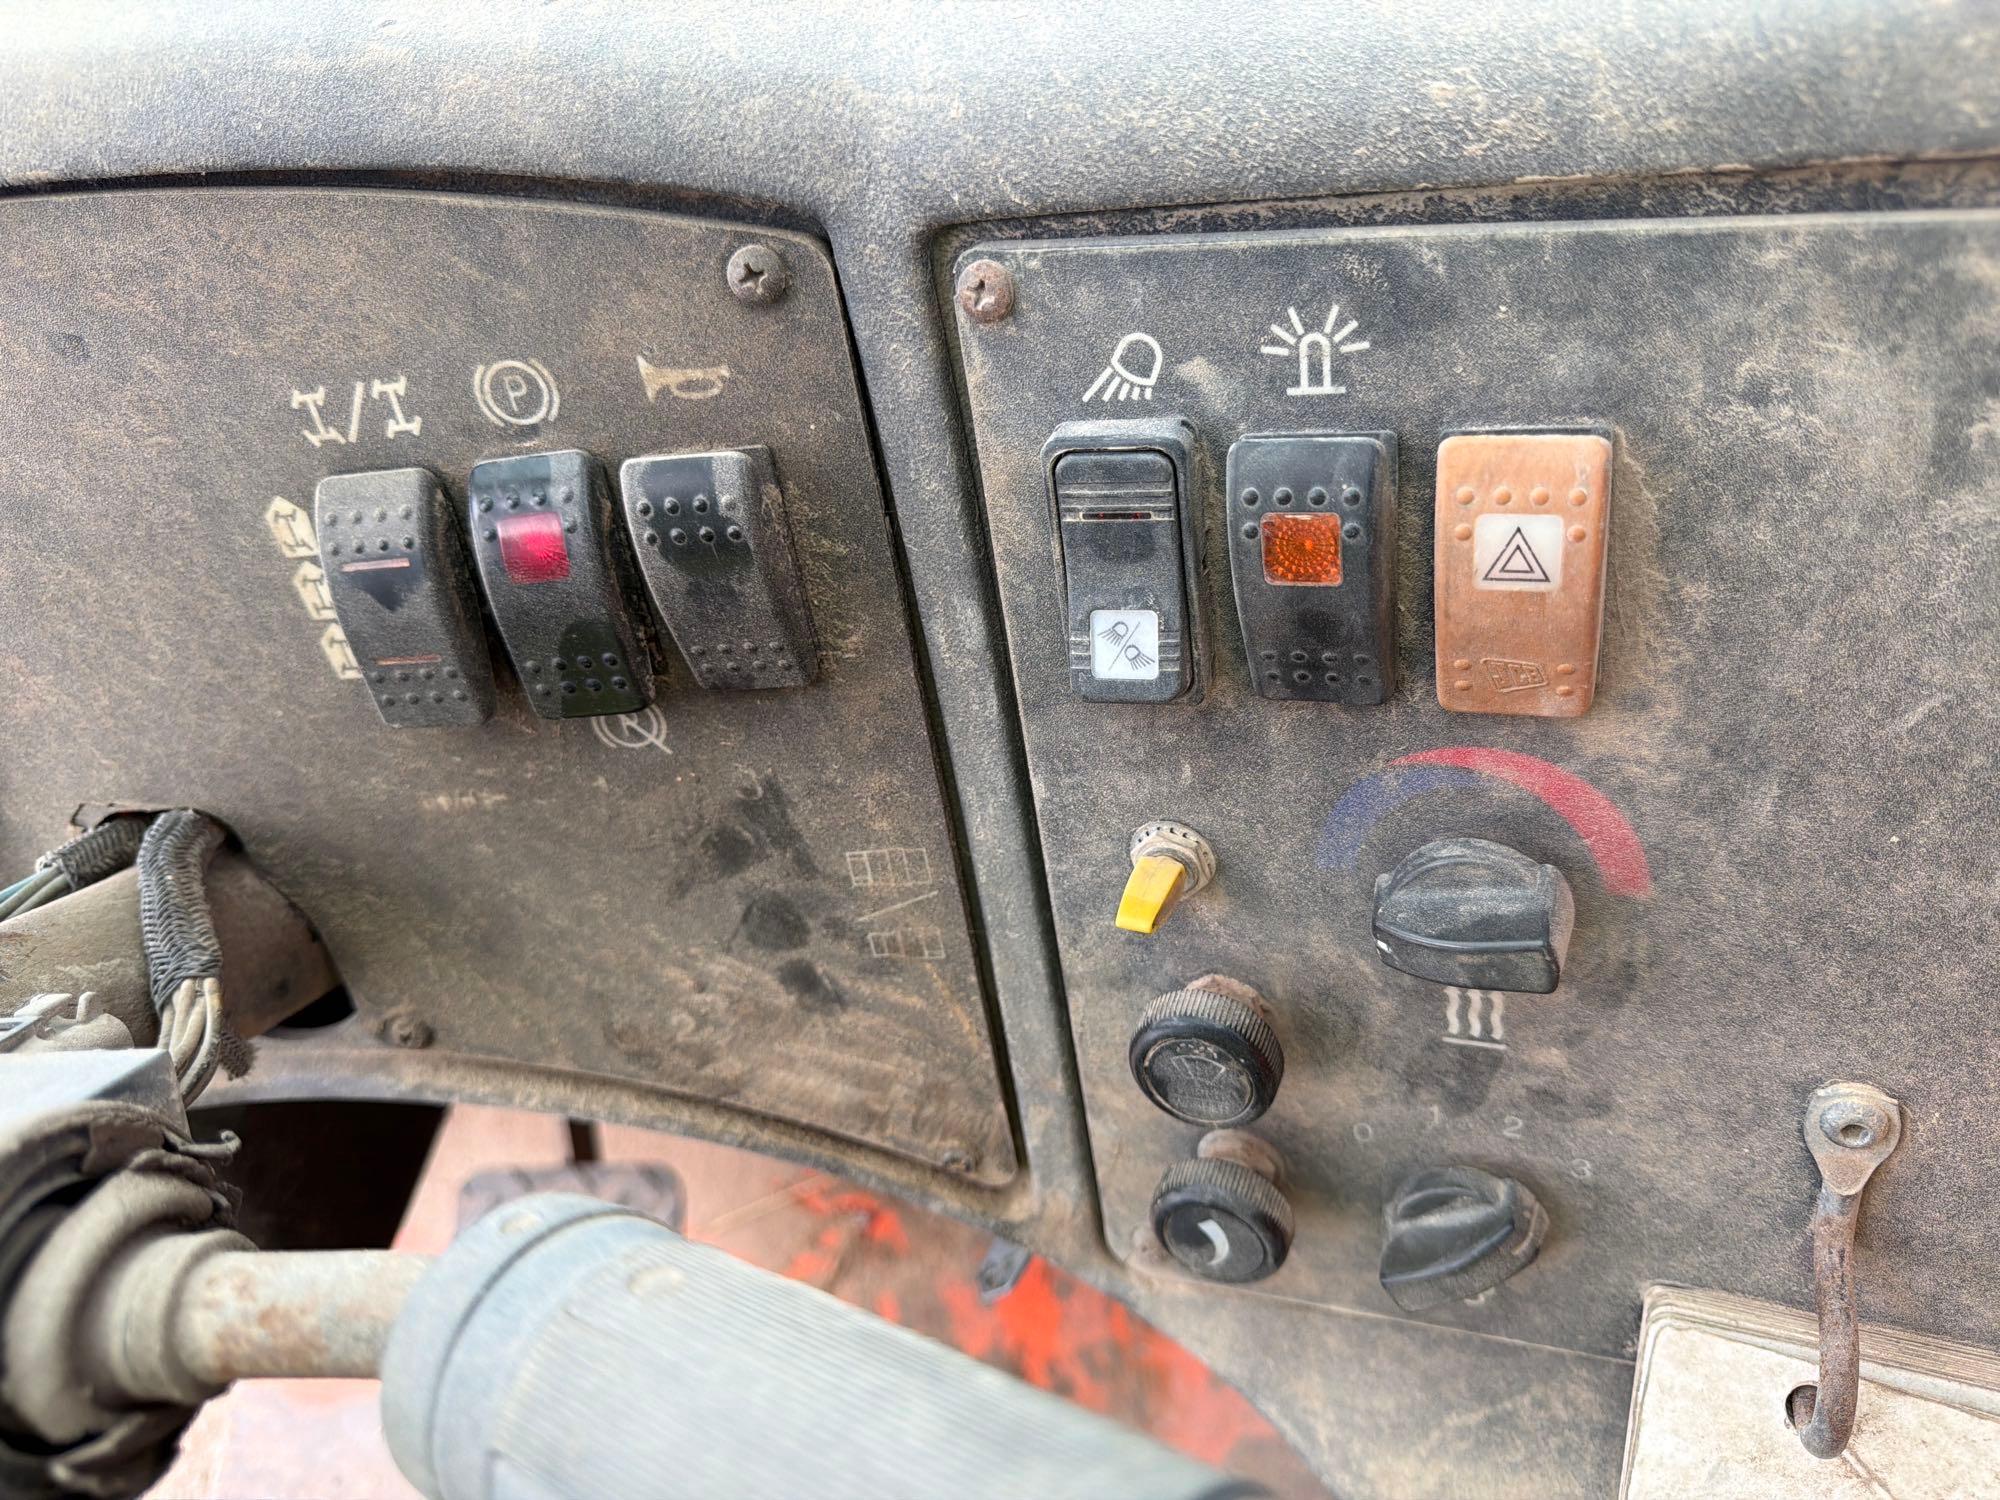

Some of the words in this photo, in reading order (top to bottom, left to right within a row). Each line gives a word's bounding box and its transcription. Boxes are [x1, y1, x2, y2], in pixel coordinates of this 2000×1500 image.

[503, 375, 527, 412] P
[1430, 1104, 1441, 1125] 1
[1502, 1115, 1524, 1139] 2
[1570, 1157, 1593, 1180] 3
